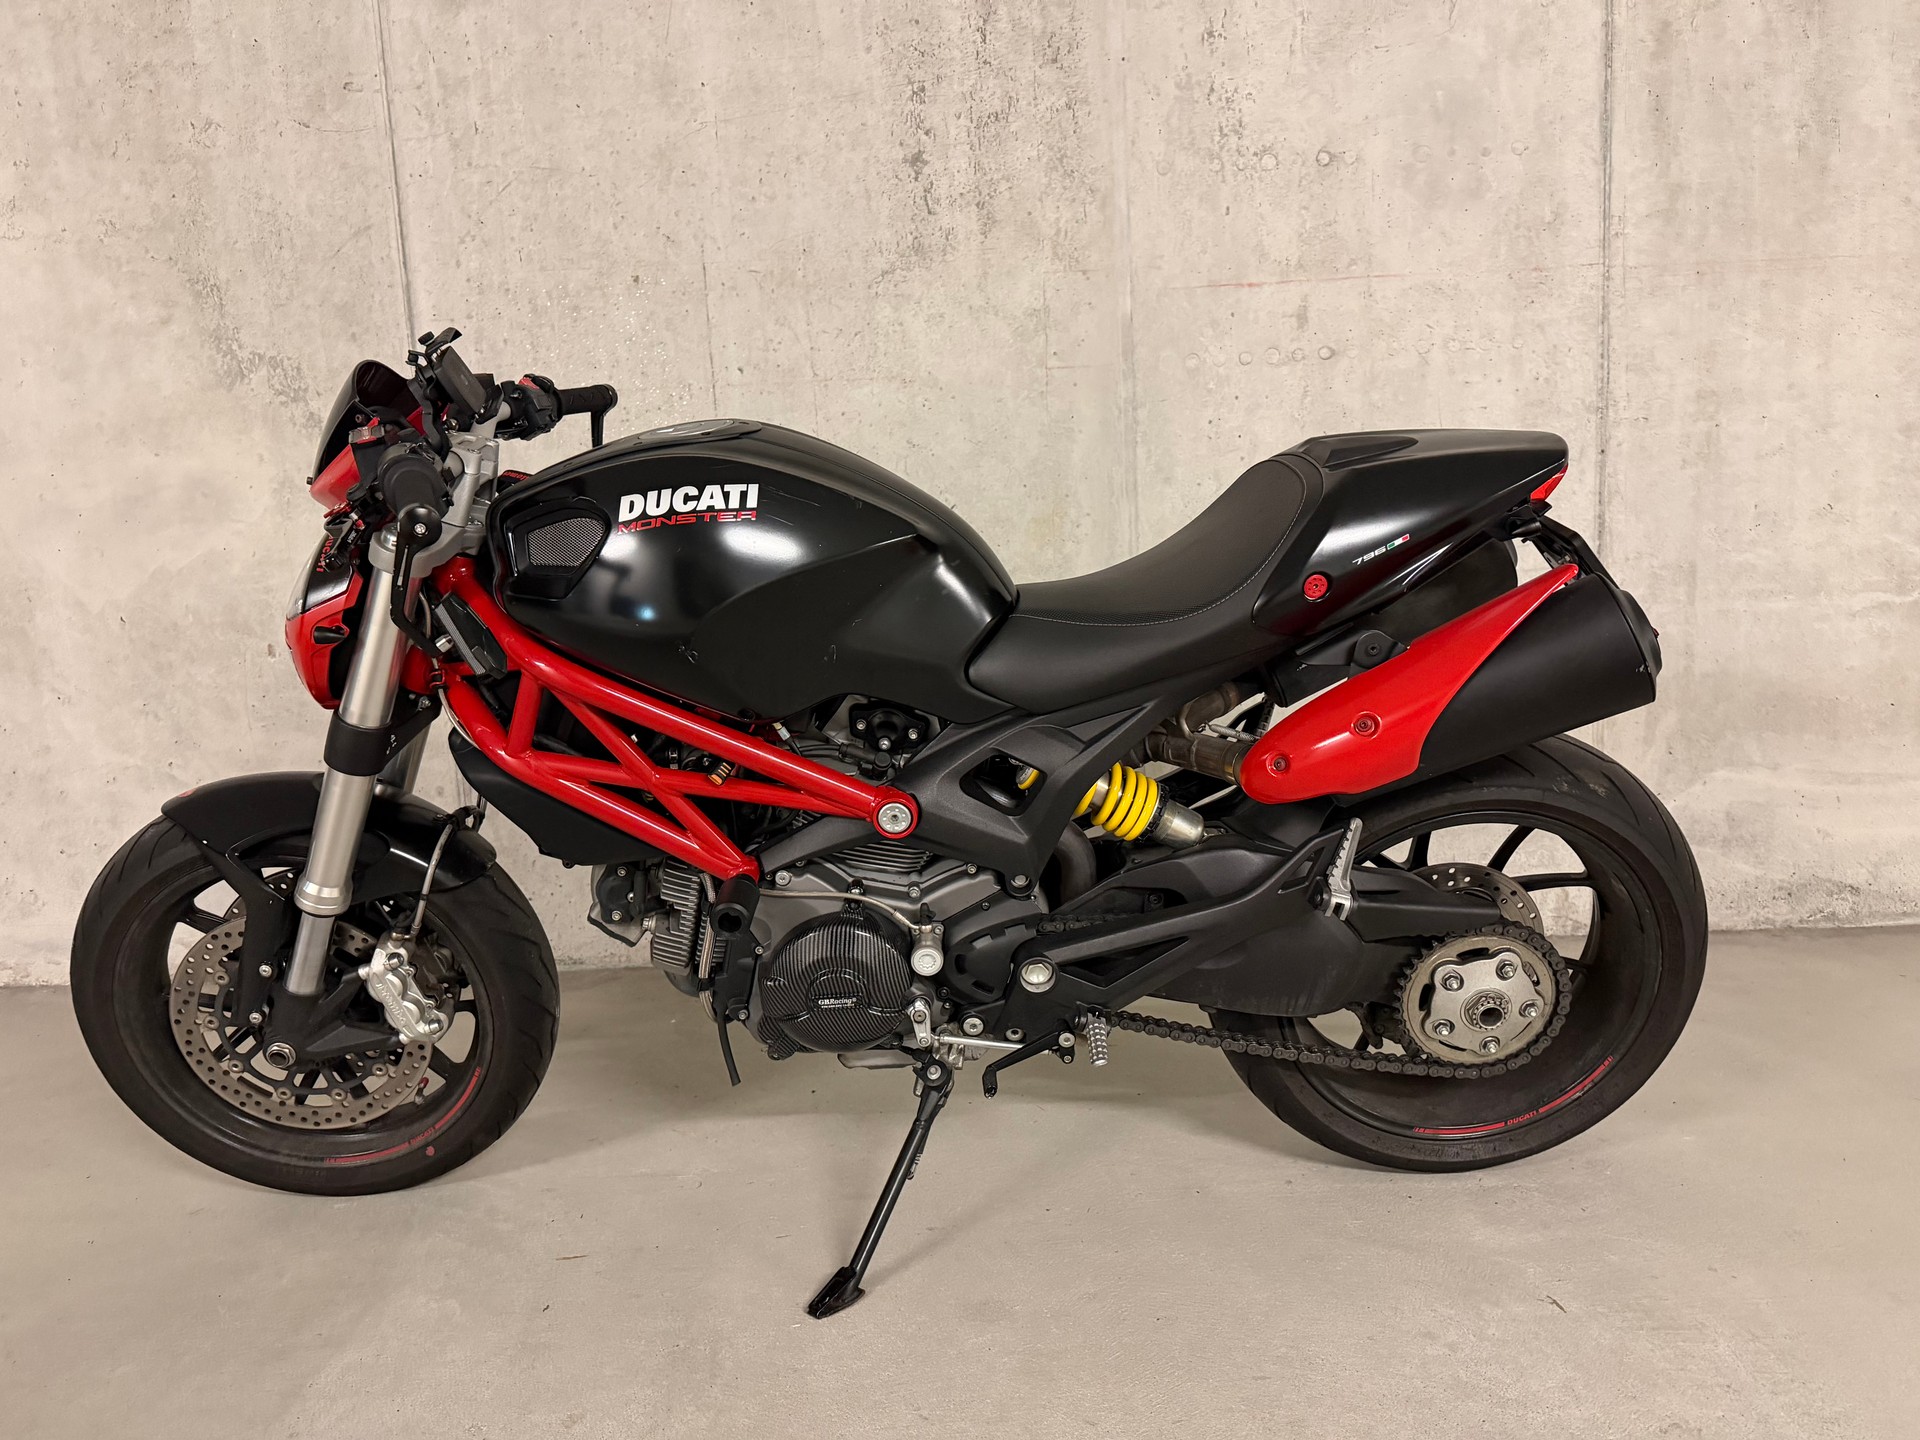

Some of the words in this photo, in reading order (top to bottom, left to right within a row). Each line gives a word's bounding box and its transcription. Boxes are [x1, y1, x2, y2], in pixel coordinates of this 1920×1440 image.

[618, 483, 759, 522] DUCATI
[617, 510, 757, 534] MONSTER
[1352, 545, 1386, 565] 796
[1507, 1110, 1538, 1126] DUCATI
